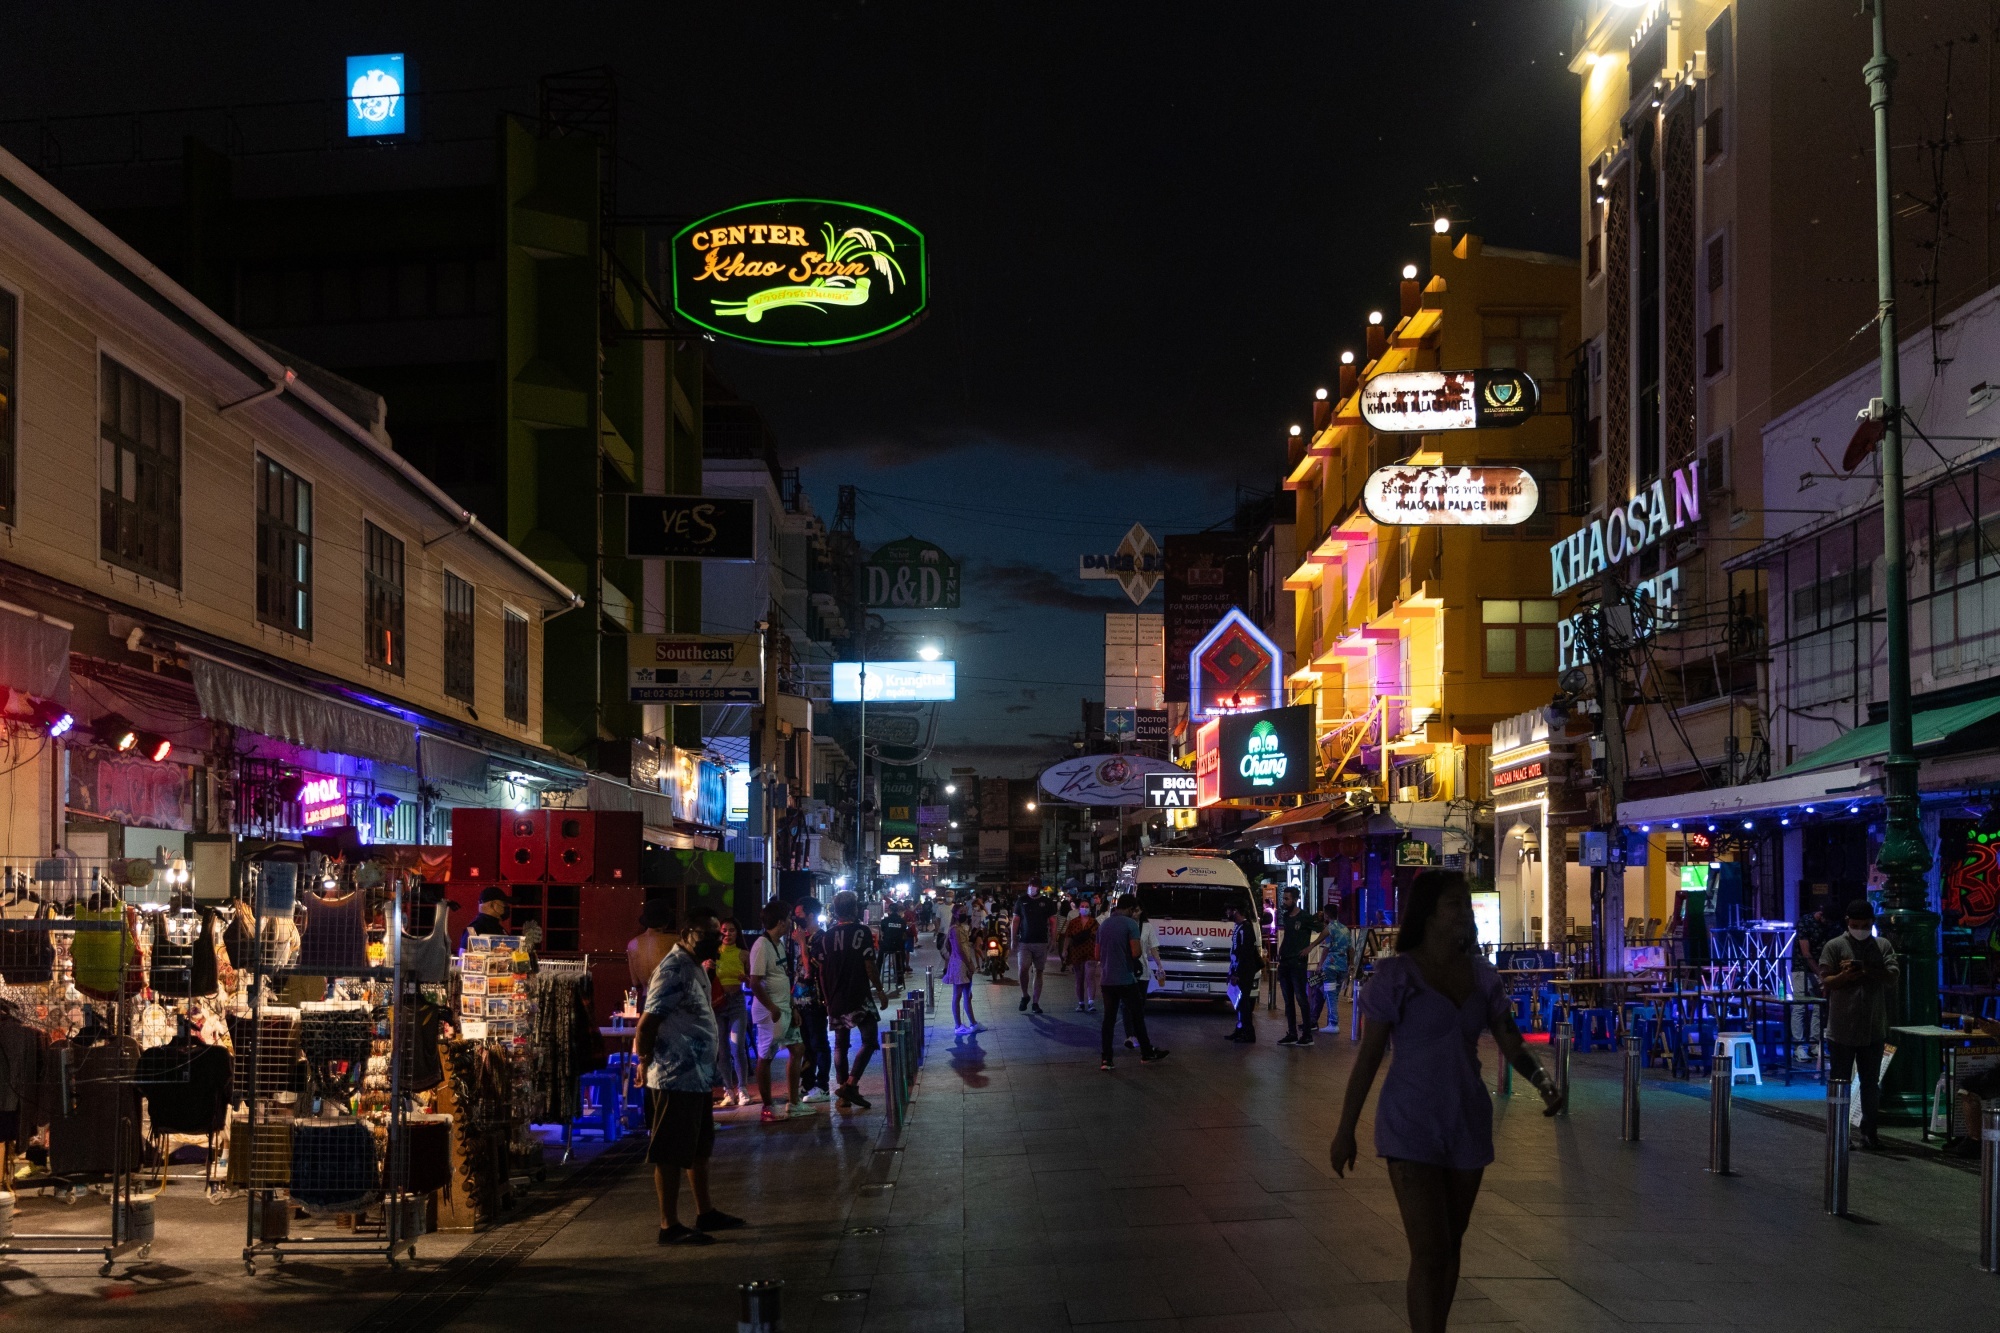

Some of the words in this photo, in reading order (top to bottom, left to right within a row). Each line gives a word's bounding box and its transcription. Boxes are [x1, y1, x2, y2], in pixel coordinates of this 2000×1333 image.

[692, 224, 809, 251] CENTER
[693, 247, 785, 281] Khao
[789, 251, 869, 282] Sarn
[1368, 402, 1409, 415] KHAOSAN
[1411, 400, 1446, 413] PALACE
[1395, 500, 1445, 511] KHAOSAN
[1448, 501, 1486, 511] PALACE
[1489, 501, 1508, 511] INN
[661, 503, 717, 545] YES
[1550, 460, 1701, 596] KHAOSAN
[866, 565, 942, 607] D&D
[945, 566, 957, 604] INN
[656, 645, 734, 660] Southeast
[1137, 716, 1167, 724] DOCTOR
[1137, 726, 1167, 735] CLINIC
[1239, 754, 1288, 779] Chang
[1494, 772, 1512, 787] KHAOSAN
[1512, 766, 1527, 781] PALACE
[1528, 762, 1542, 778] HOTEL
[1956, 1047, 1985, 1055] BUCKET
